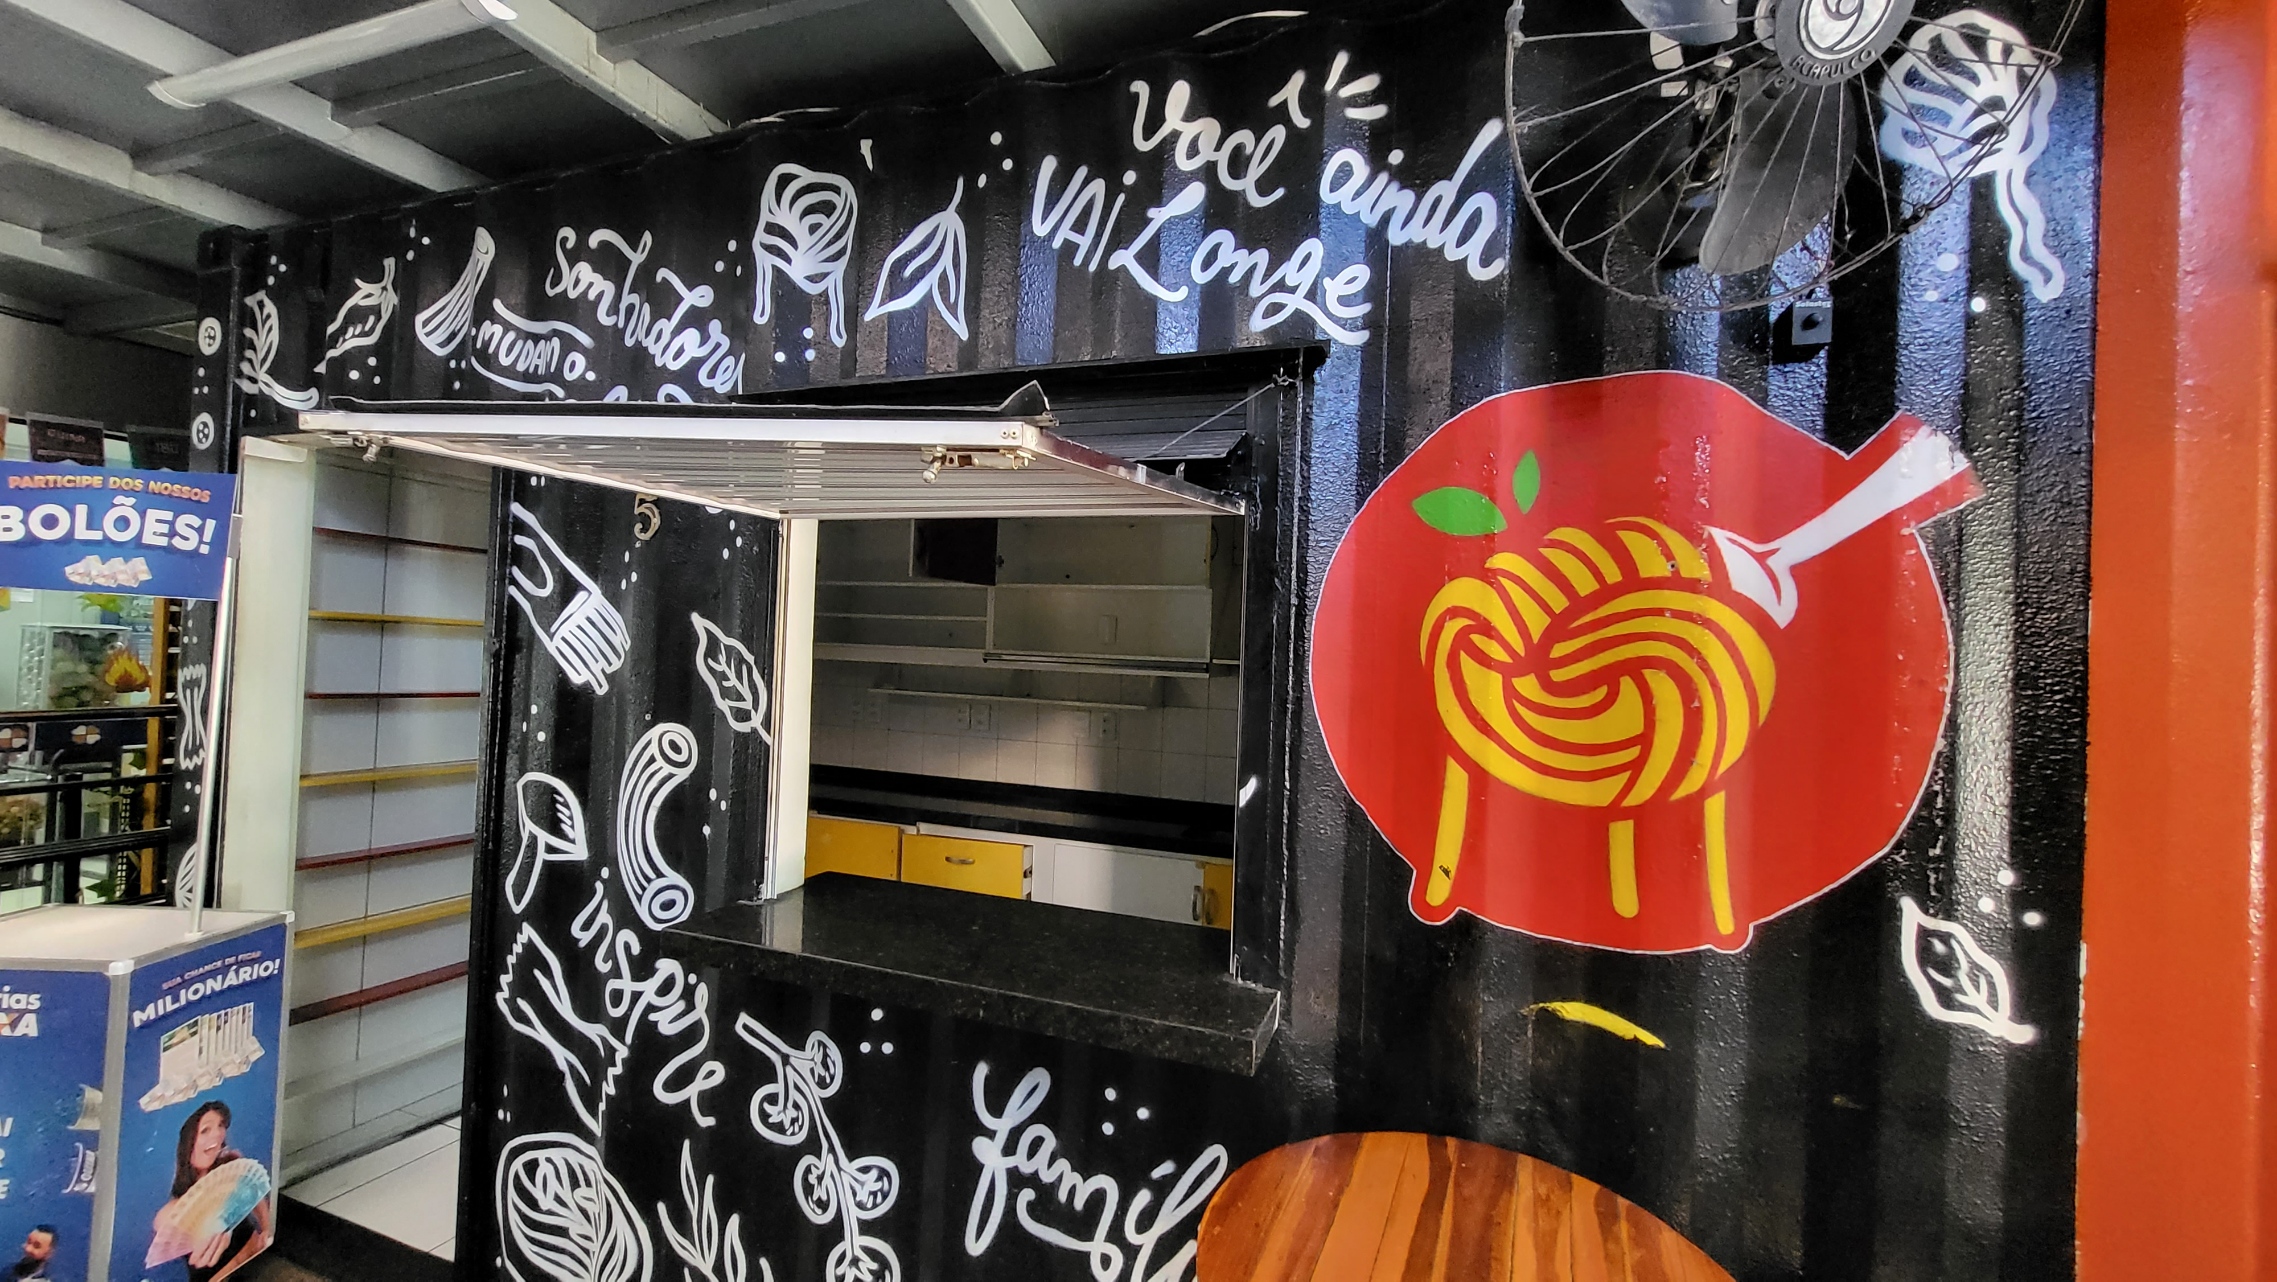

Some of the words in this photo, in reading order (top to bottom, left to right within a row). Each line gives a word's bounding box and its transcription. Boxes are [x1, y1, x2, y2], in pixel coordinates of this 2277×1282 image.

[1790, 48, 1876, 79] ACAPULCO
[1320, 118, 1505, 281] ainda
[1108, 181, 1372, 346] Longe
[9, 475, 103, 489] PARTICIPE
[108, 477, 144, 491] DOS
[148, 480, 212, 503] NOSSOS
[0, 494, 217, 555] BOLÕES!
[132, 958, 281, 1028] MILIONÁRIO!
[184, 960, 223, 980] CHANCE
[224, 956, 237, 966] DE
